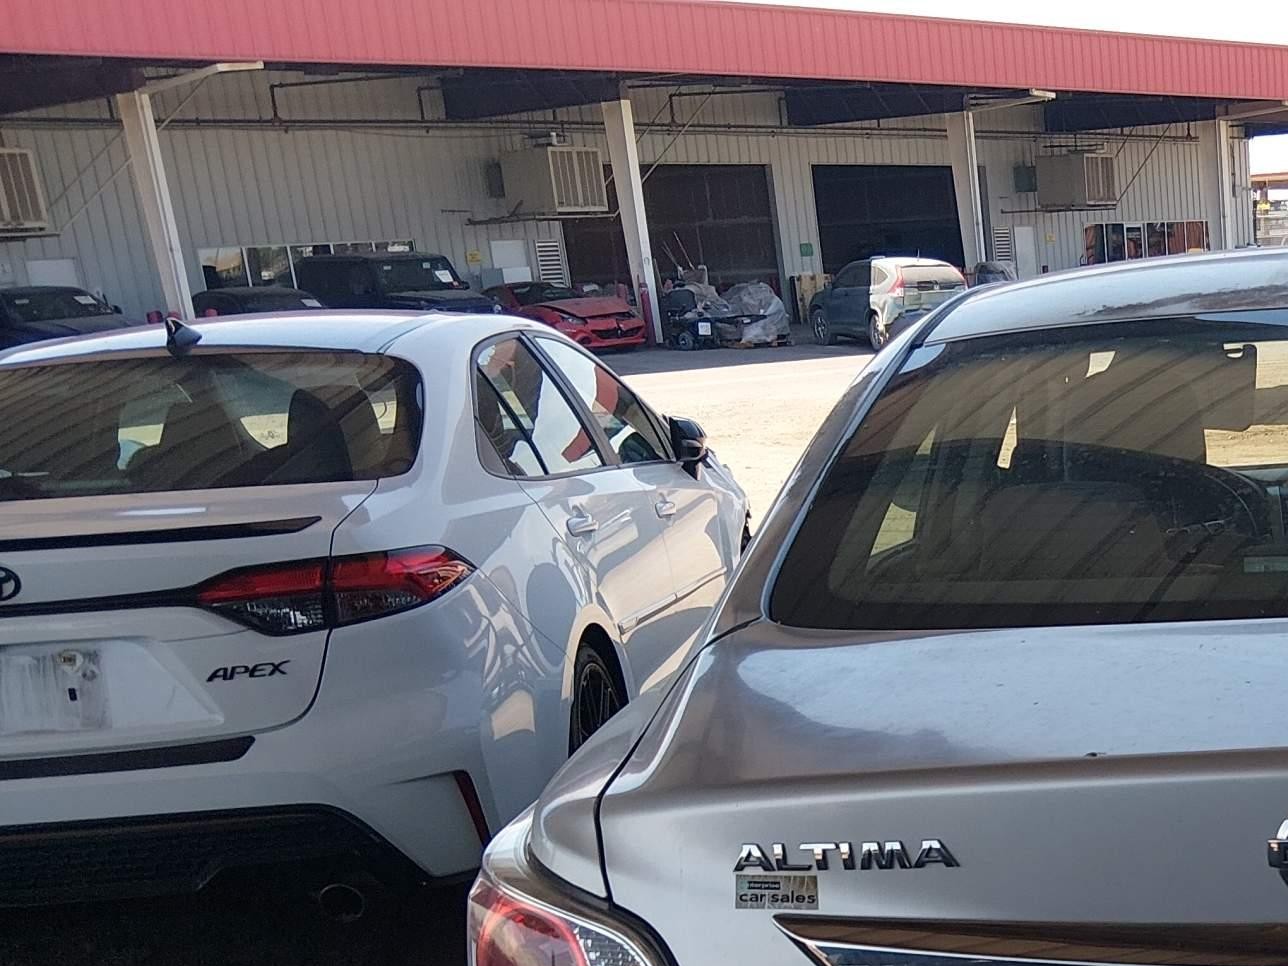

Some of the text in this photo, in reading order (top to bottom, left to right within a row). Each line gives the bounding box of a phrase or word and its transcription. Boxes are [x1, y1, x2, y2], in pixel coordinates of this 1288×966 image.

[207, 659, 290, 682] APEX
[733, 839, 961, 872] ALTIMA
[739, 890, 816, 903] car sales
